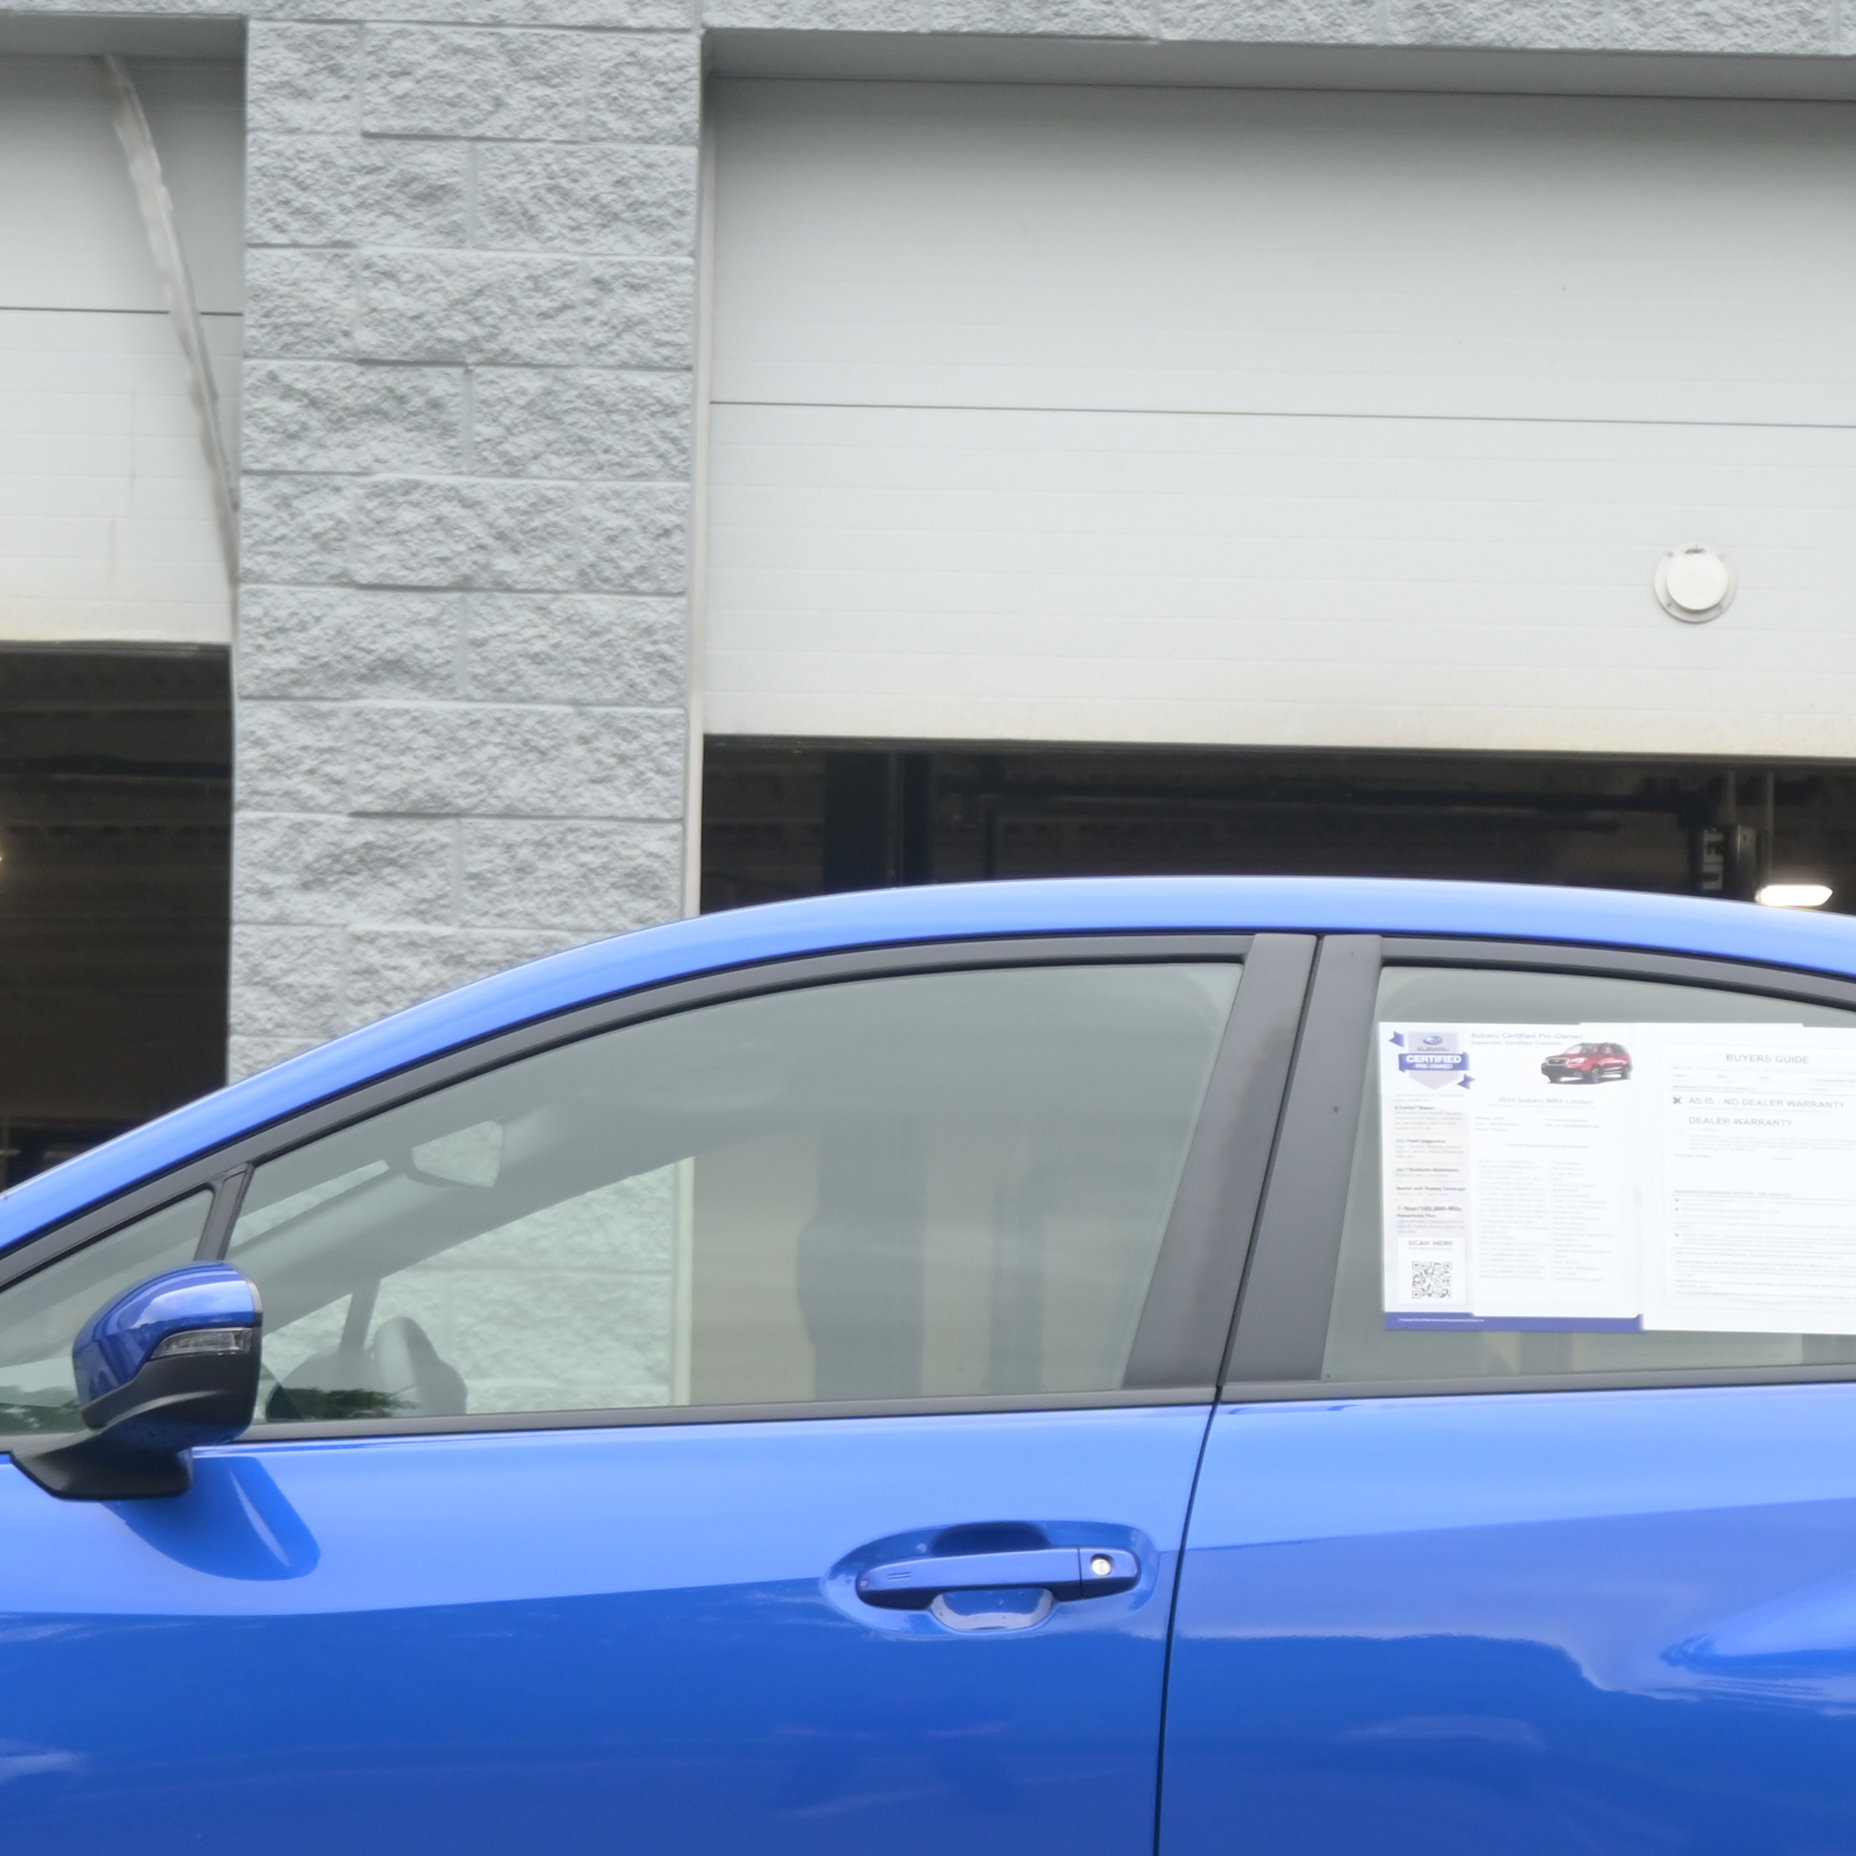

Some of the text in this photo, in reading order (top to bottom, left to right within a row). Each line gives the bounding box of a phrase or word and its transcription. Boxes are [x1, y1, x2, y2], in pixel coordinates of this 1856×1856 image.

[1702, 828, 1725, 891] LIFT
[1405, 1054, 1463, 1064] CERTIFIED
[1725, 1053, 1810, 1065] BUYERS GUIDE
[1688, 1097, 1702, 1105] AS
[1704, 1097, 1714, 1105] IS
[1724, 1097, 1739, 1106] NO
[1742, 1098, 1784, 1107] DEALER
[1786, 1099, 1846, 1109] WARRANTY
[1688, 1116, 1794, 1127] DEALER WARRANTY
